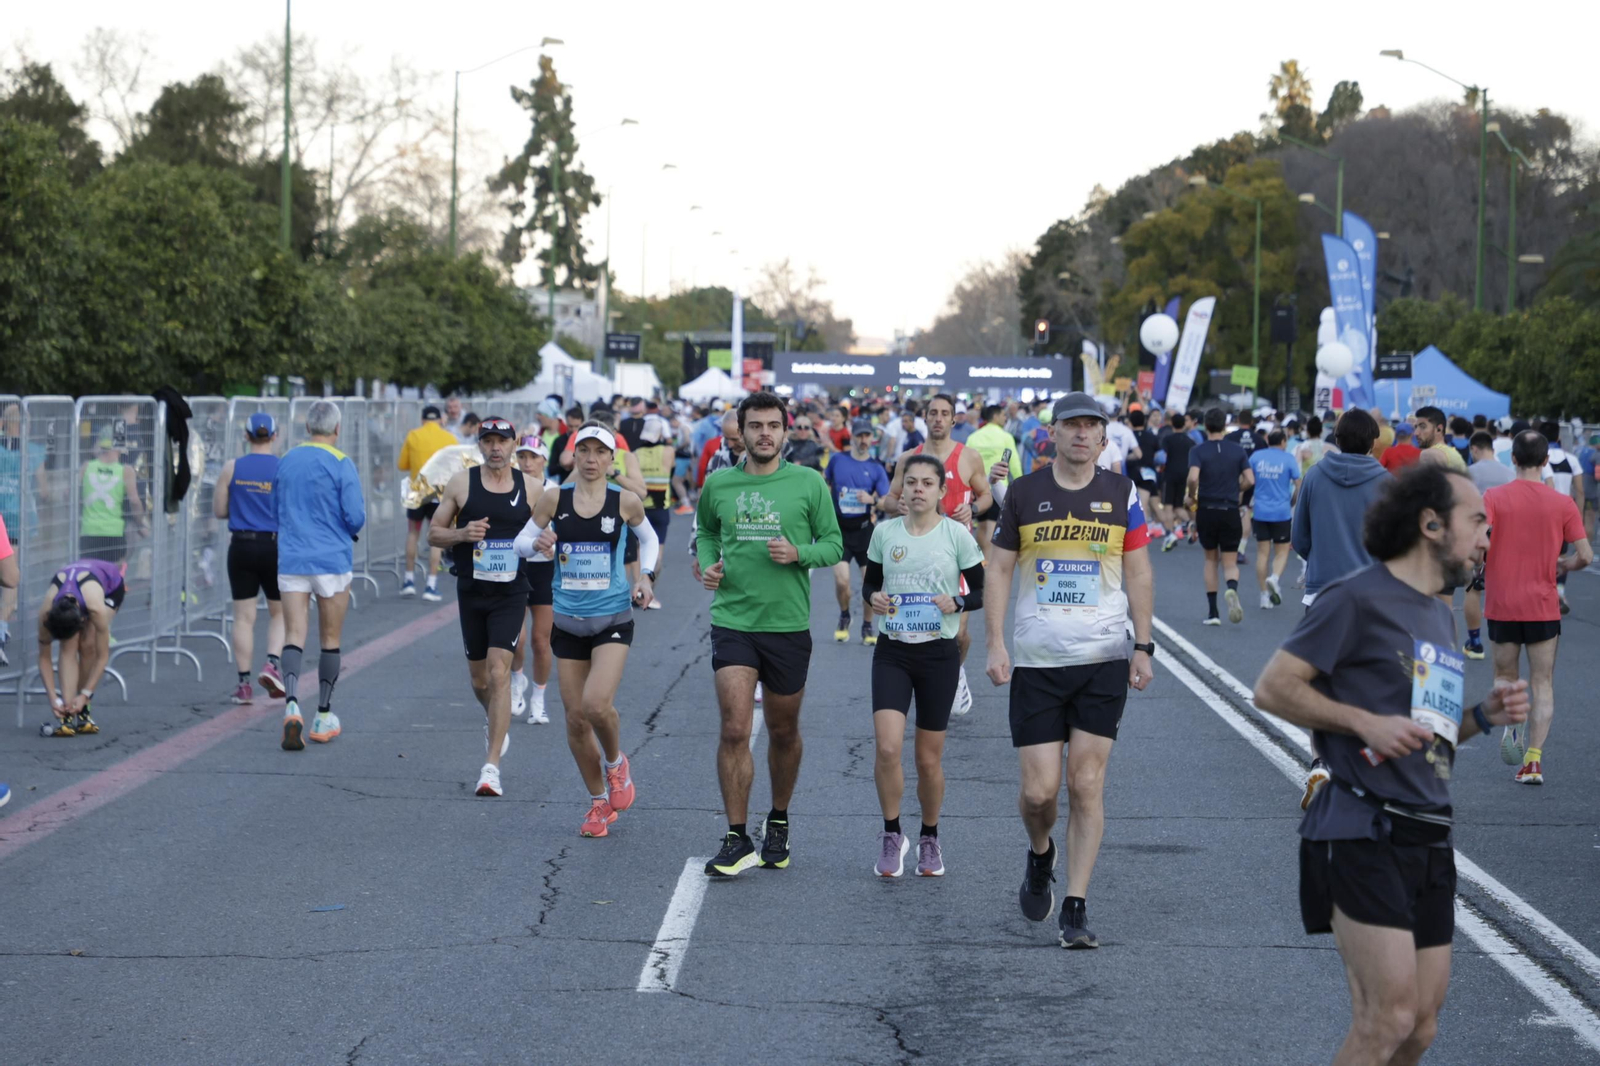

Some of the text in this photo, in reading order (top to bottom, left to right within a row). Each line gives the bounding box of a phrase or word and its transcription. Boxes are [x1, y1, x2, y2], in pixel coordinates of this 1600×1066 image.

[487, 563, 506, 571] JAVI
[1058, 564, 1092, 572] ZURICH
[1048, 592, 1085, 604] JANEZ
[886, 622, 940, 631] RITA SANTOS
